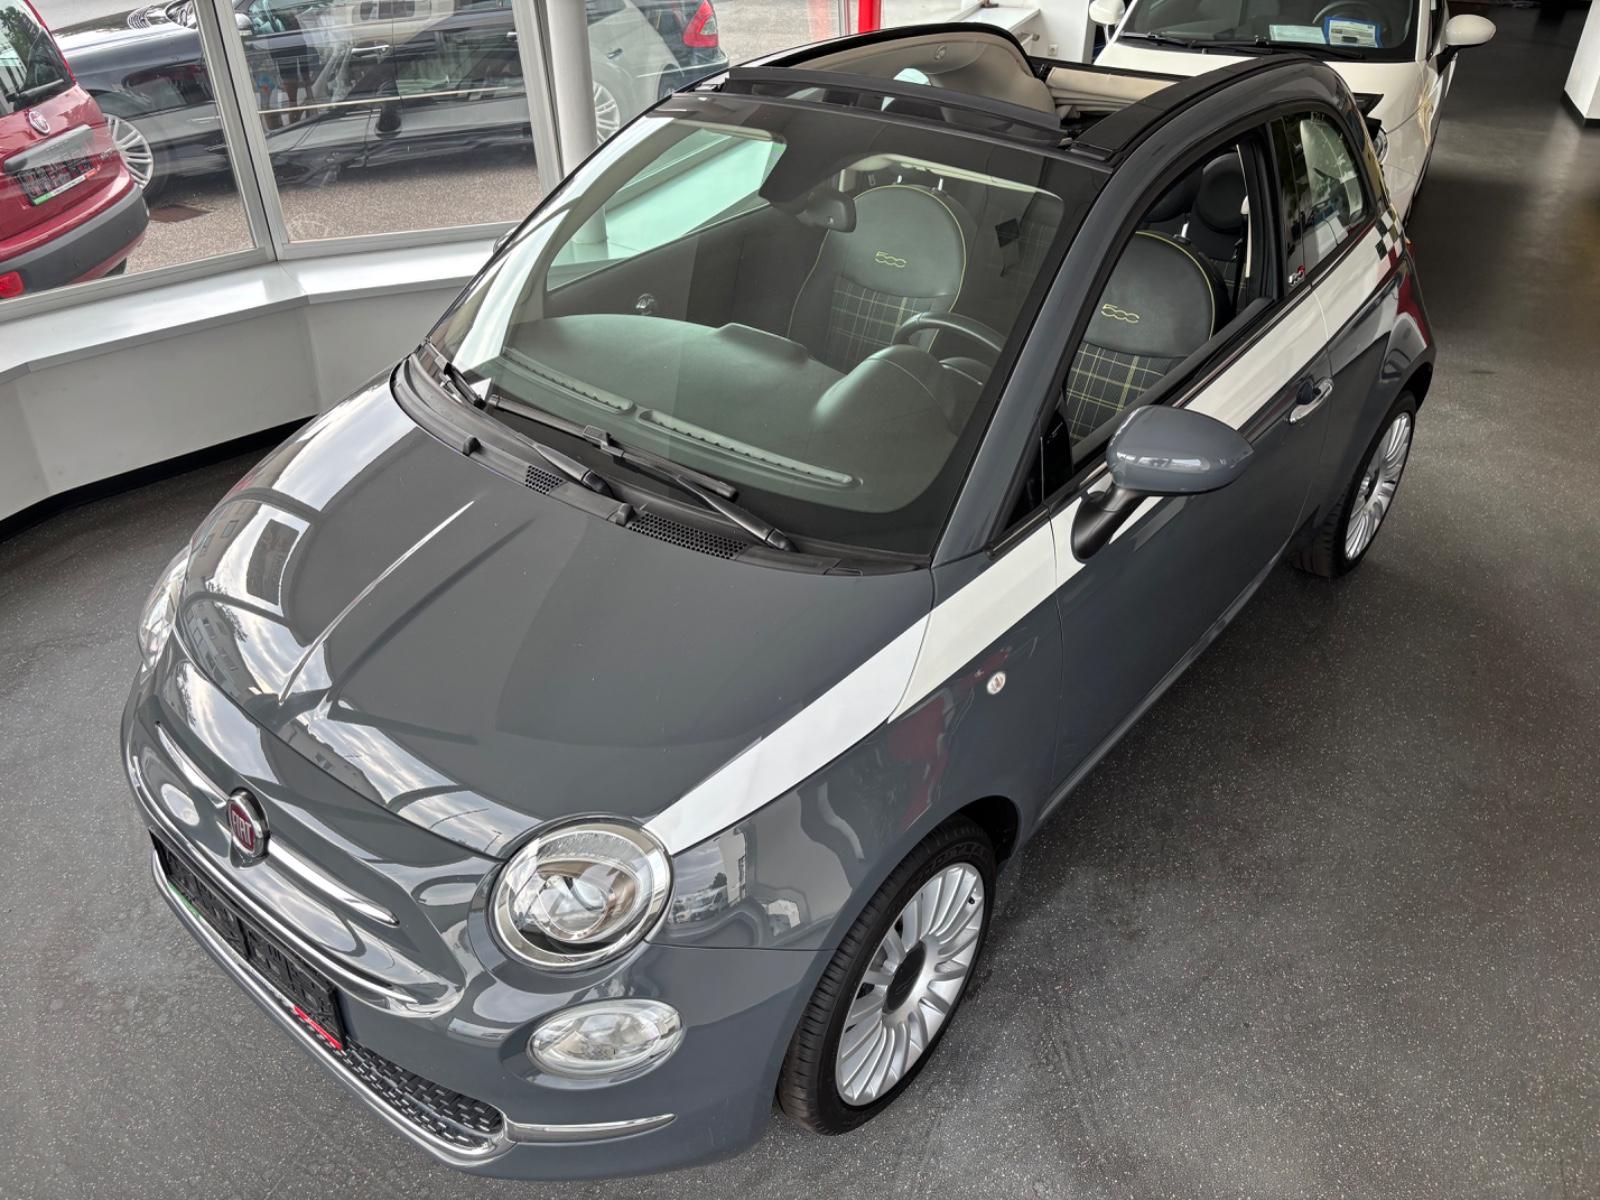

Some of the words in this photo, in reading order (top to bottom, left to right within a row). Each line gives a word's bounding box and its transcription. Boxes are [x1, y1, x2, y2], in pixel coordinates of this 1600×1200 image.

[875, 250, 907, 268] 500
[1101, 303, 1140, 324] 500
[231, 809, 252, 846] FIAT
